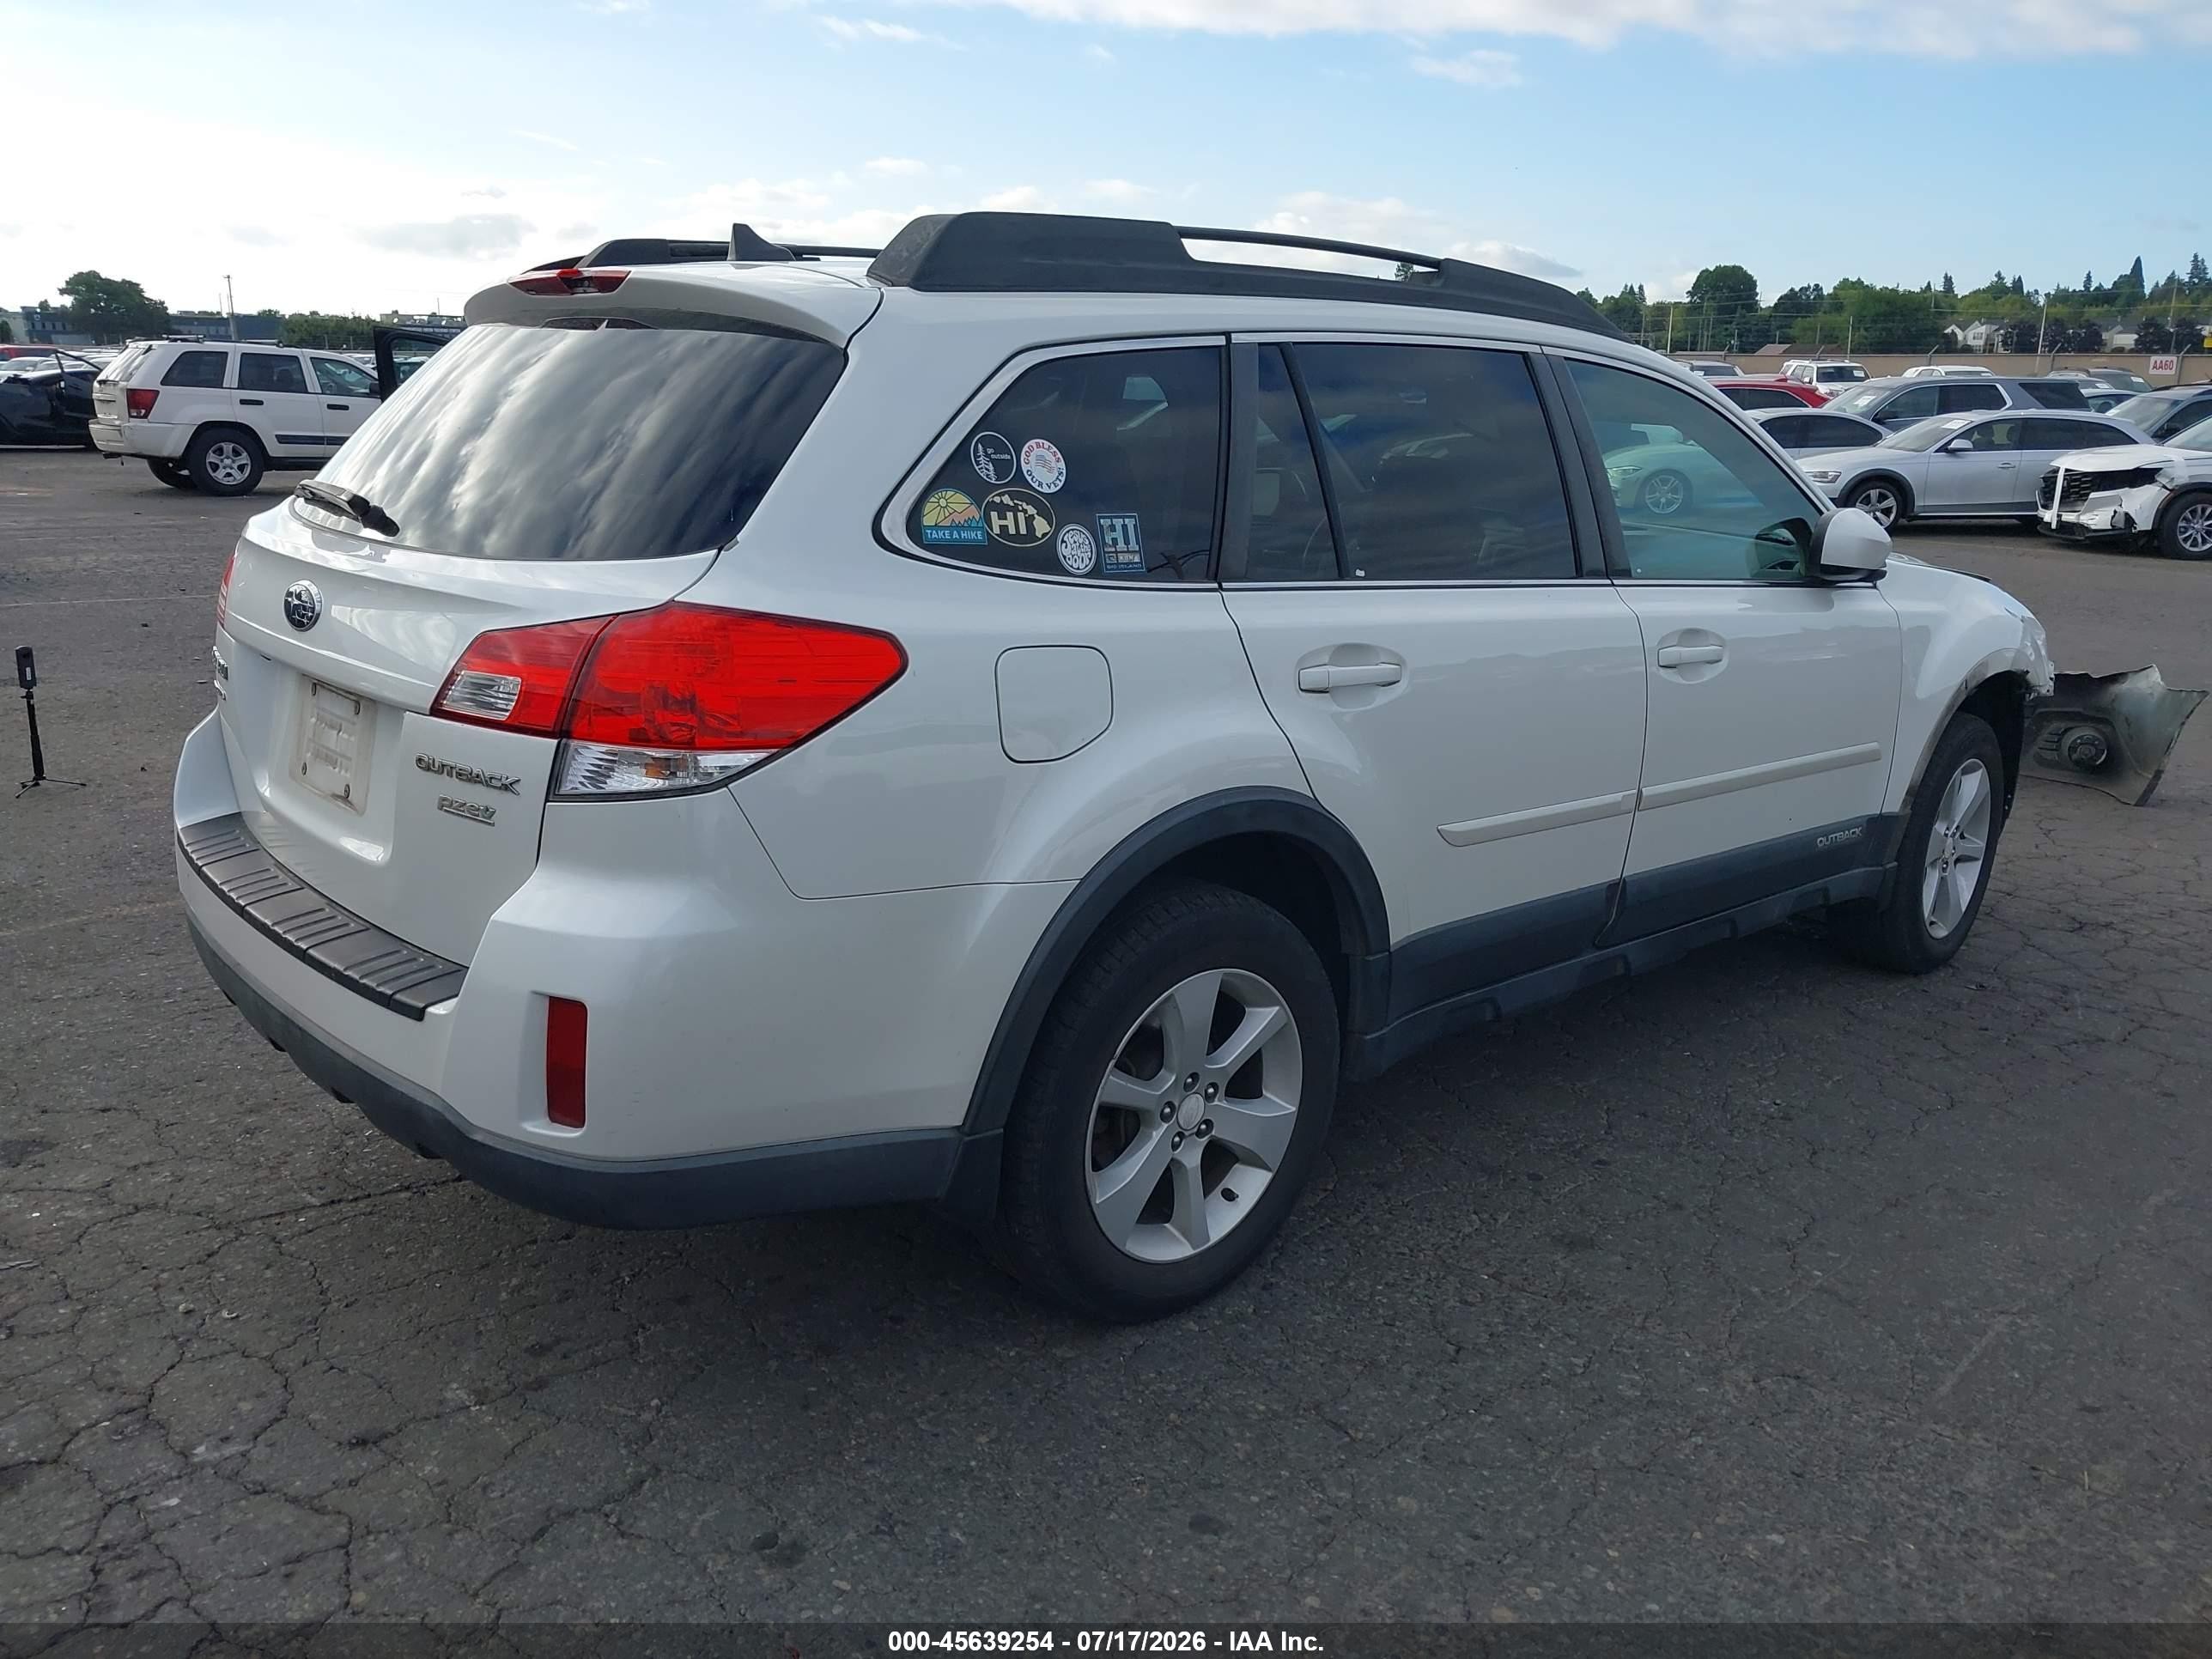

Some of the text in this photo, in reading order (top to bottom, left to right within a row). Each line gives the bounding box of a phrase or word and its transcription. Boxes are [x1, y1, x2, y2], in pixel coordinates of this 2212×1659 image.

[2152, 360, 2174, 370] AA60
[1024, 441, 1061, 465] GOD BLESS
[1026, 467, 1064, 489] OUR VETS!
[926, 530, 982, 539] TAKE A HIKE
[990, 511, 1027, 535] HI
[1100, 518, 1139, 551] HI
[416, 753, 520, 795] OUTBACK
[1817, 827, 1863, 847] OUTBACK
